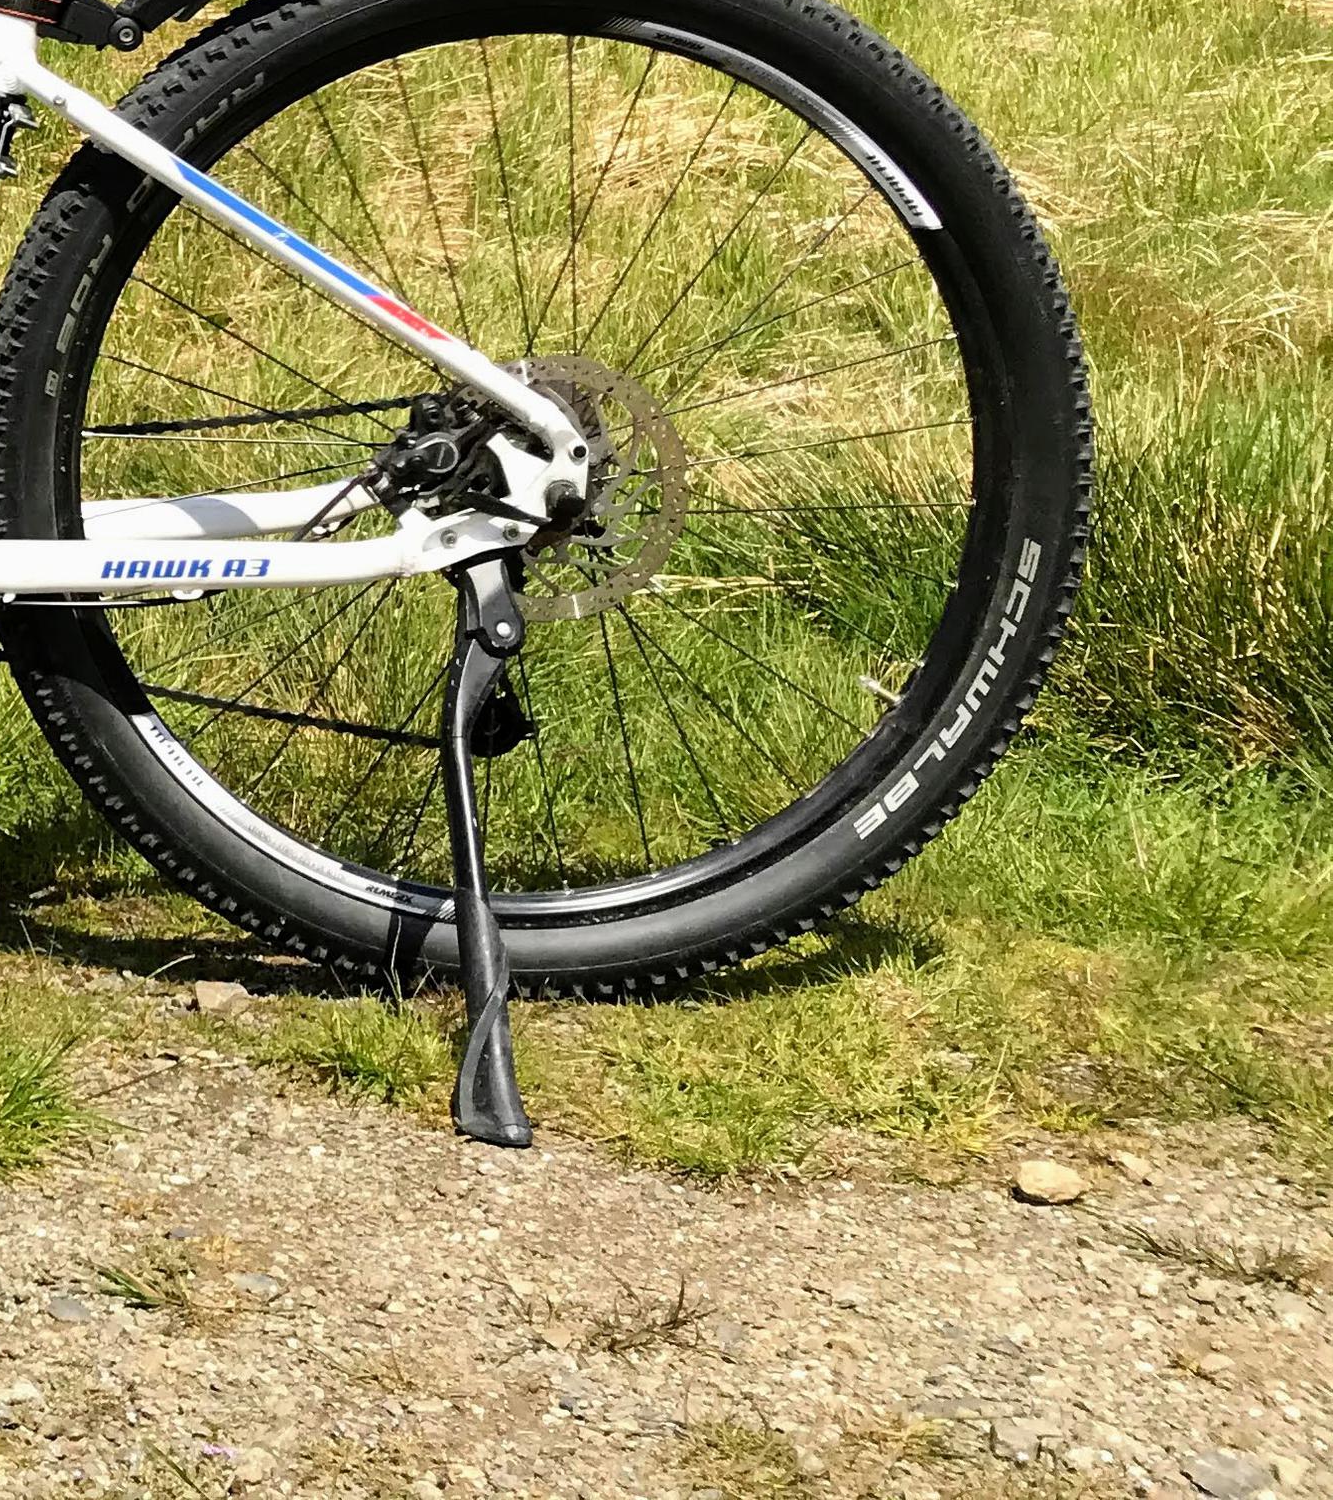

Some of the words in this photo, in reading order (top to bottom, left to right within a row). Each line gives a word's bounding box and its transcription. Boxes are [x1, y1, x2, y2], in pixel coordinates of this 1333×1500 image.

[100, 559, 213, 579] HAWK
[221, 559, 271, 578] A3
[853, 537, 1042, 840] SCHWALBE
